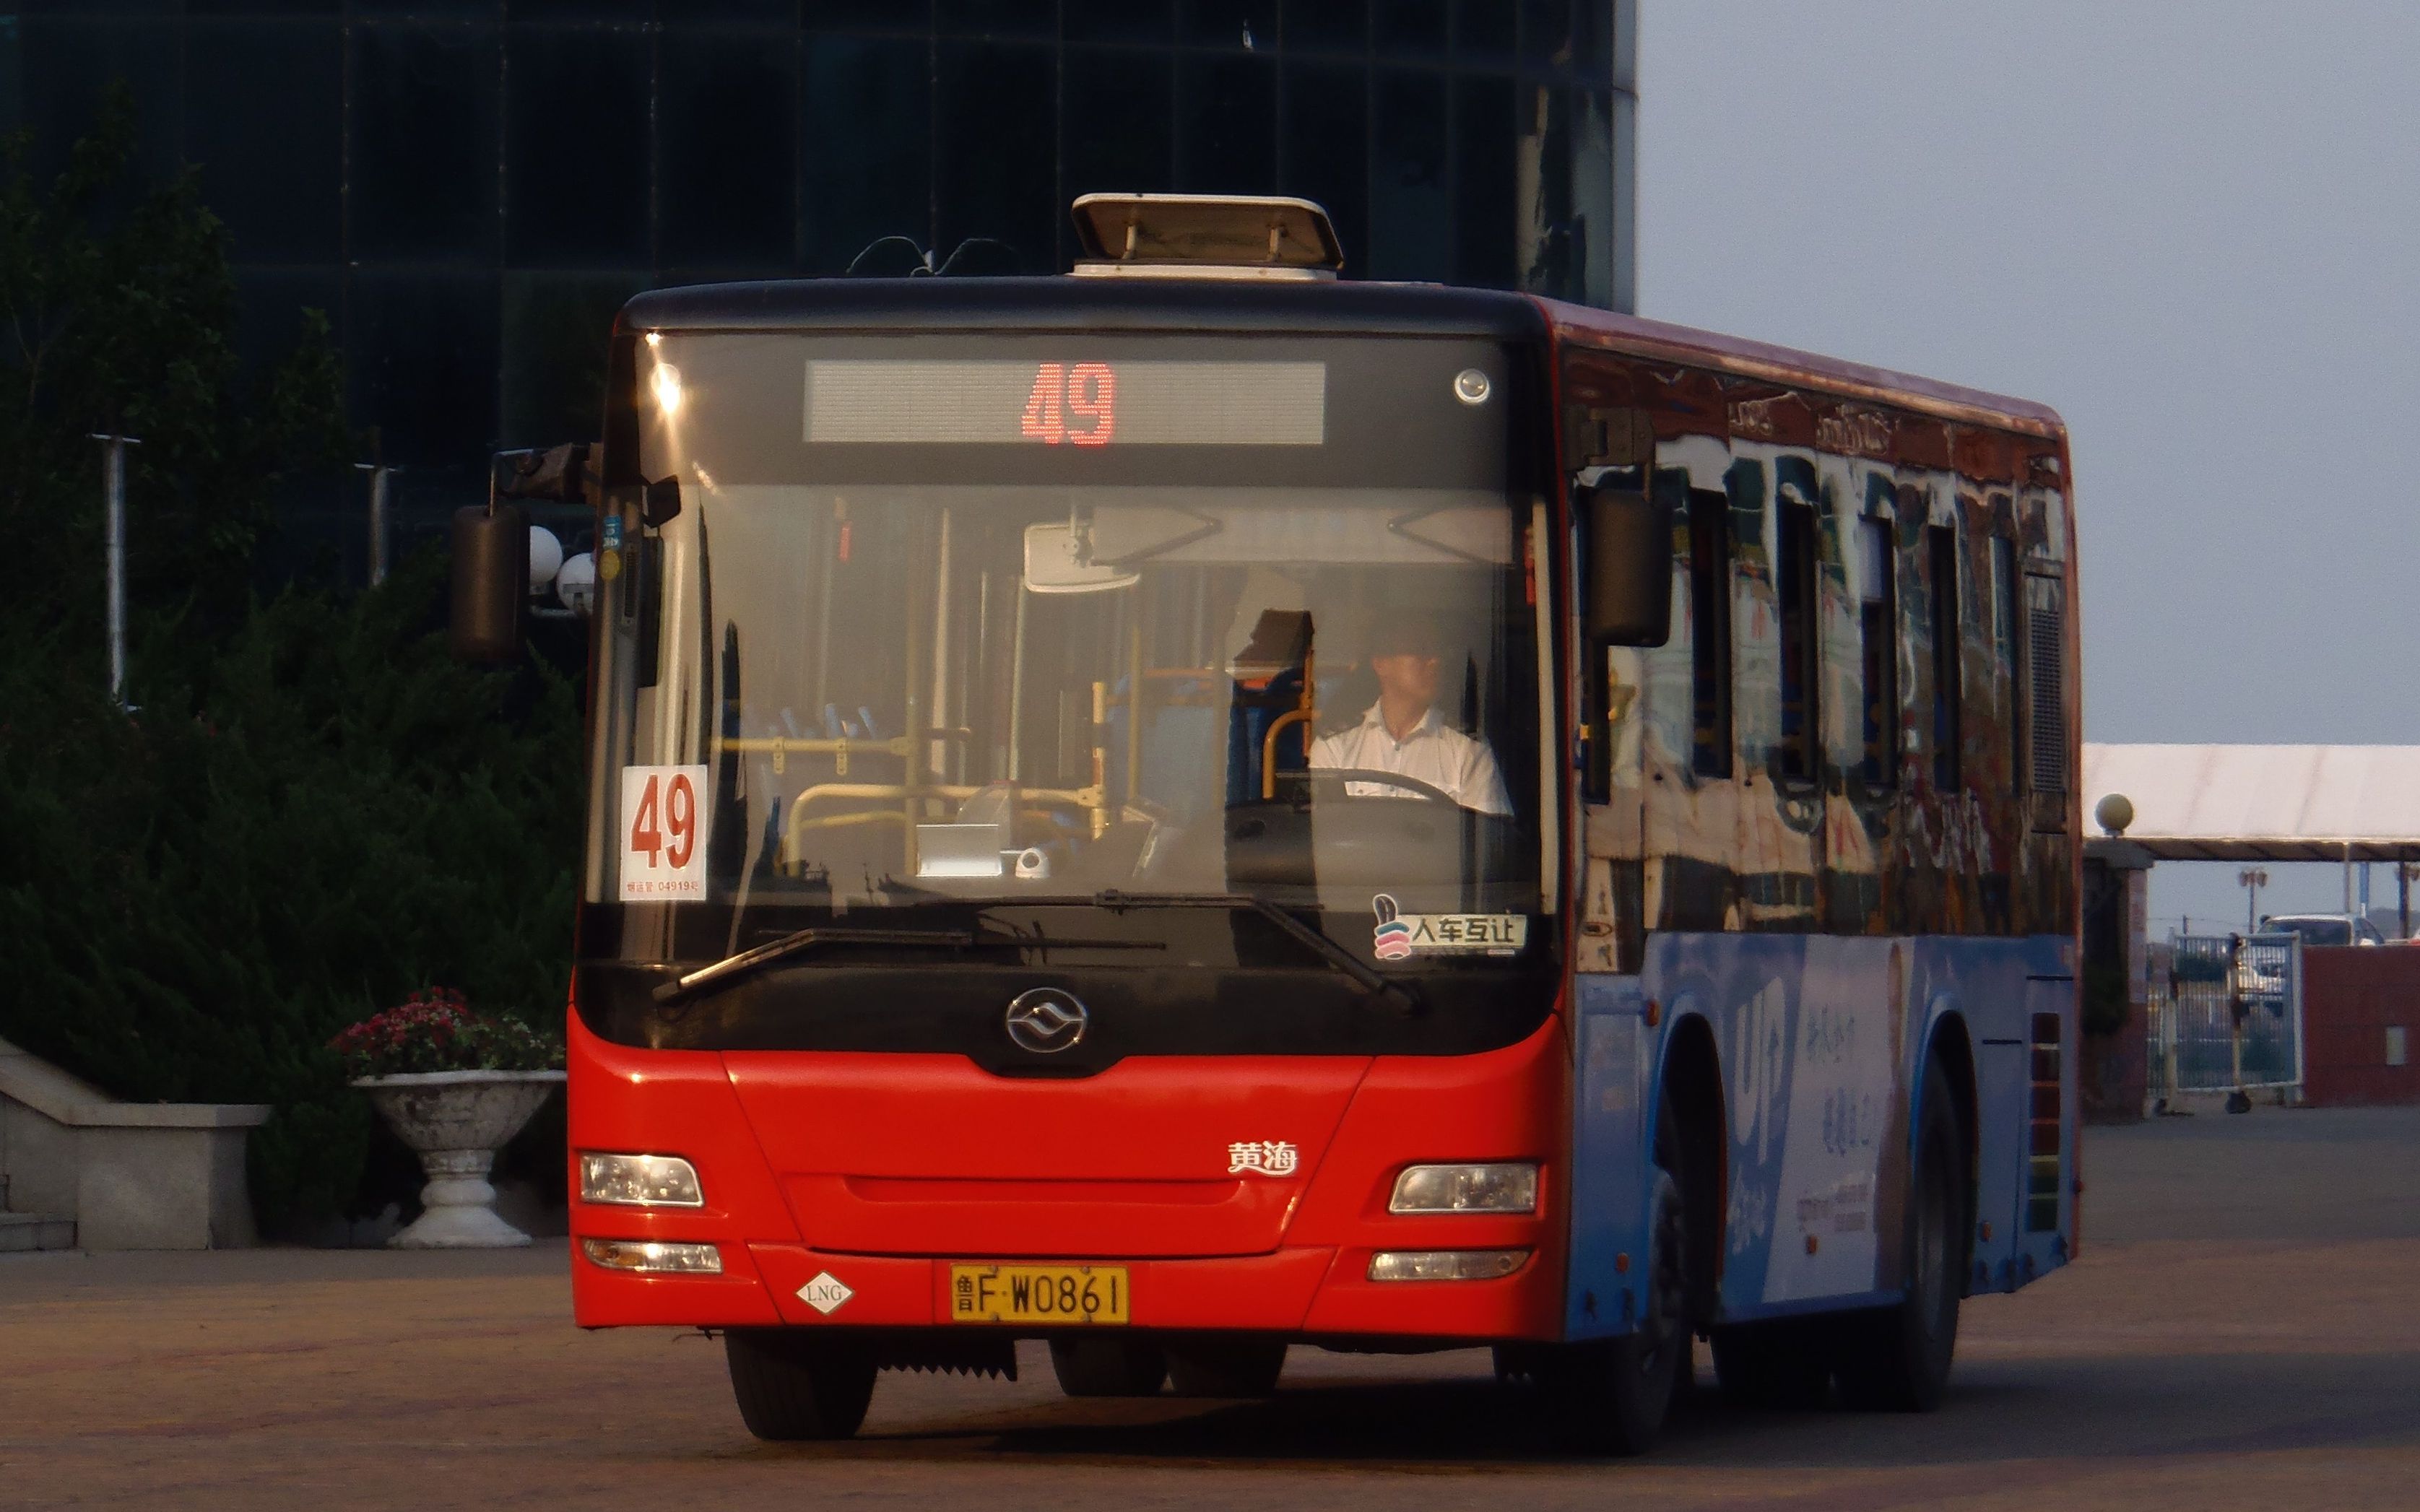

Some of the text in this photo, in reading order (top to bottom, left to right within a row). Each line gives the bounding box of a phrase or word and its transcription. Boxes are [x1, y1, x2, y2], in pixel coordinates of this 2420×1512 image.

[1020, 362, 1116, 445] 49
[631, 773, 696, 870] 49
[1413, 918, 1514, 942] 人车互让
[1228, 1140, 1298, 1176] 黄海
[806, 1285, 841, 1301] LNG
